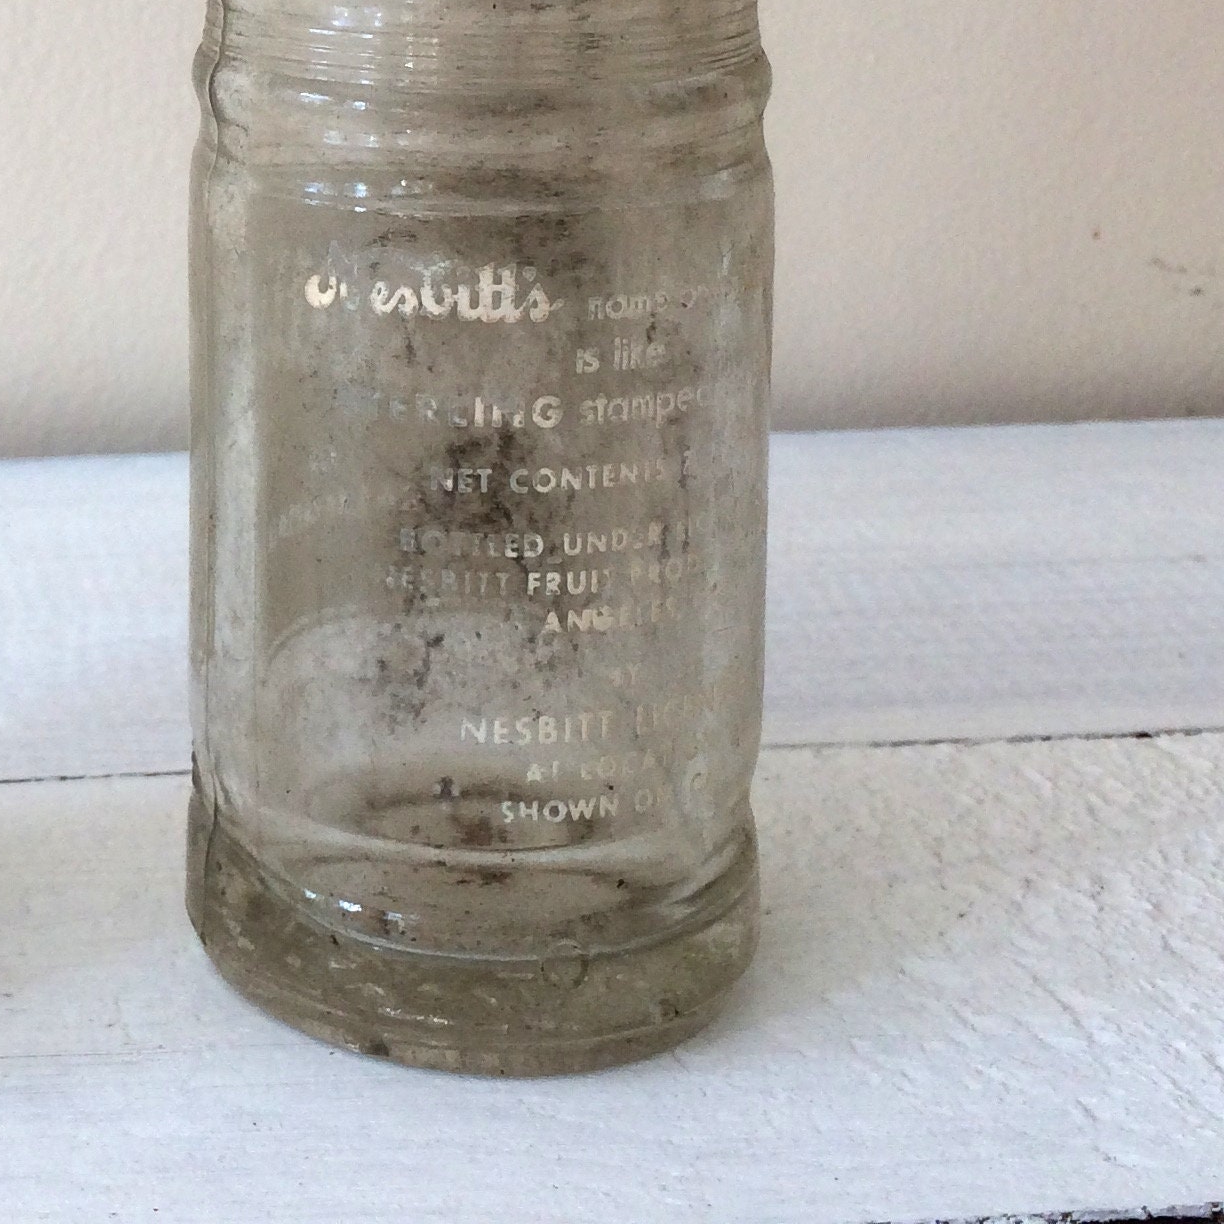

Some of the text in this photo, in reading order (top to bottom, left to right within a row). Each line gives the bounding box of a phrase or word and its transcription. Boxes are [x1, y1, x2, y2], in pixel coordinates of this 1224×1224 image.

[575, 336, 667, 374] is like
[430, 468, 492, 493] NET
[460, 710, 614, 745] NESBITT
[501, 795, 619, 824] SHOWN
